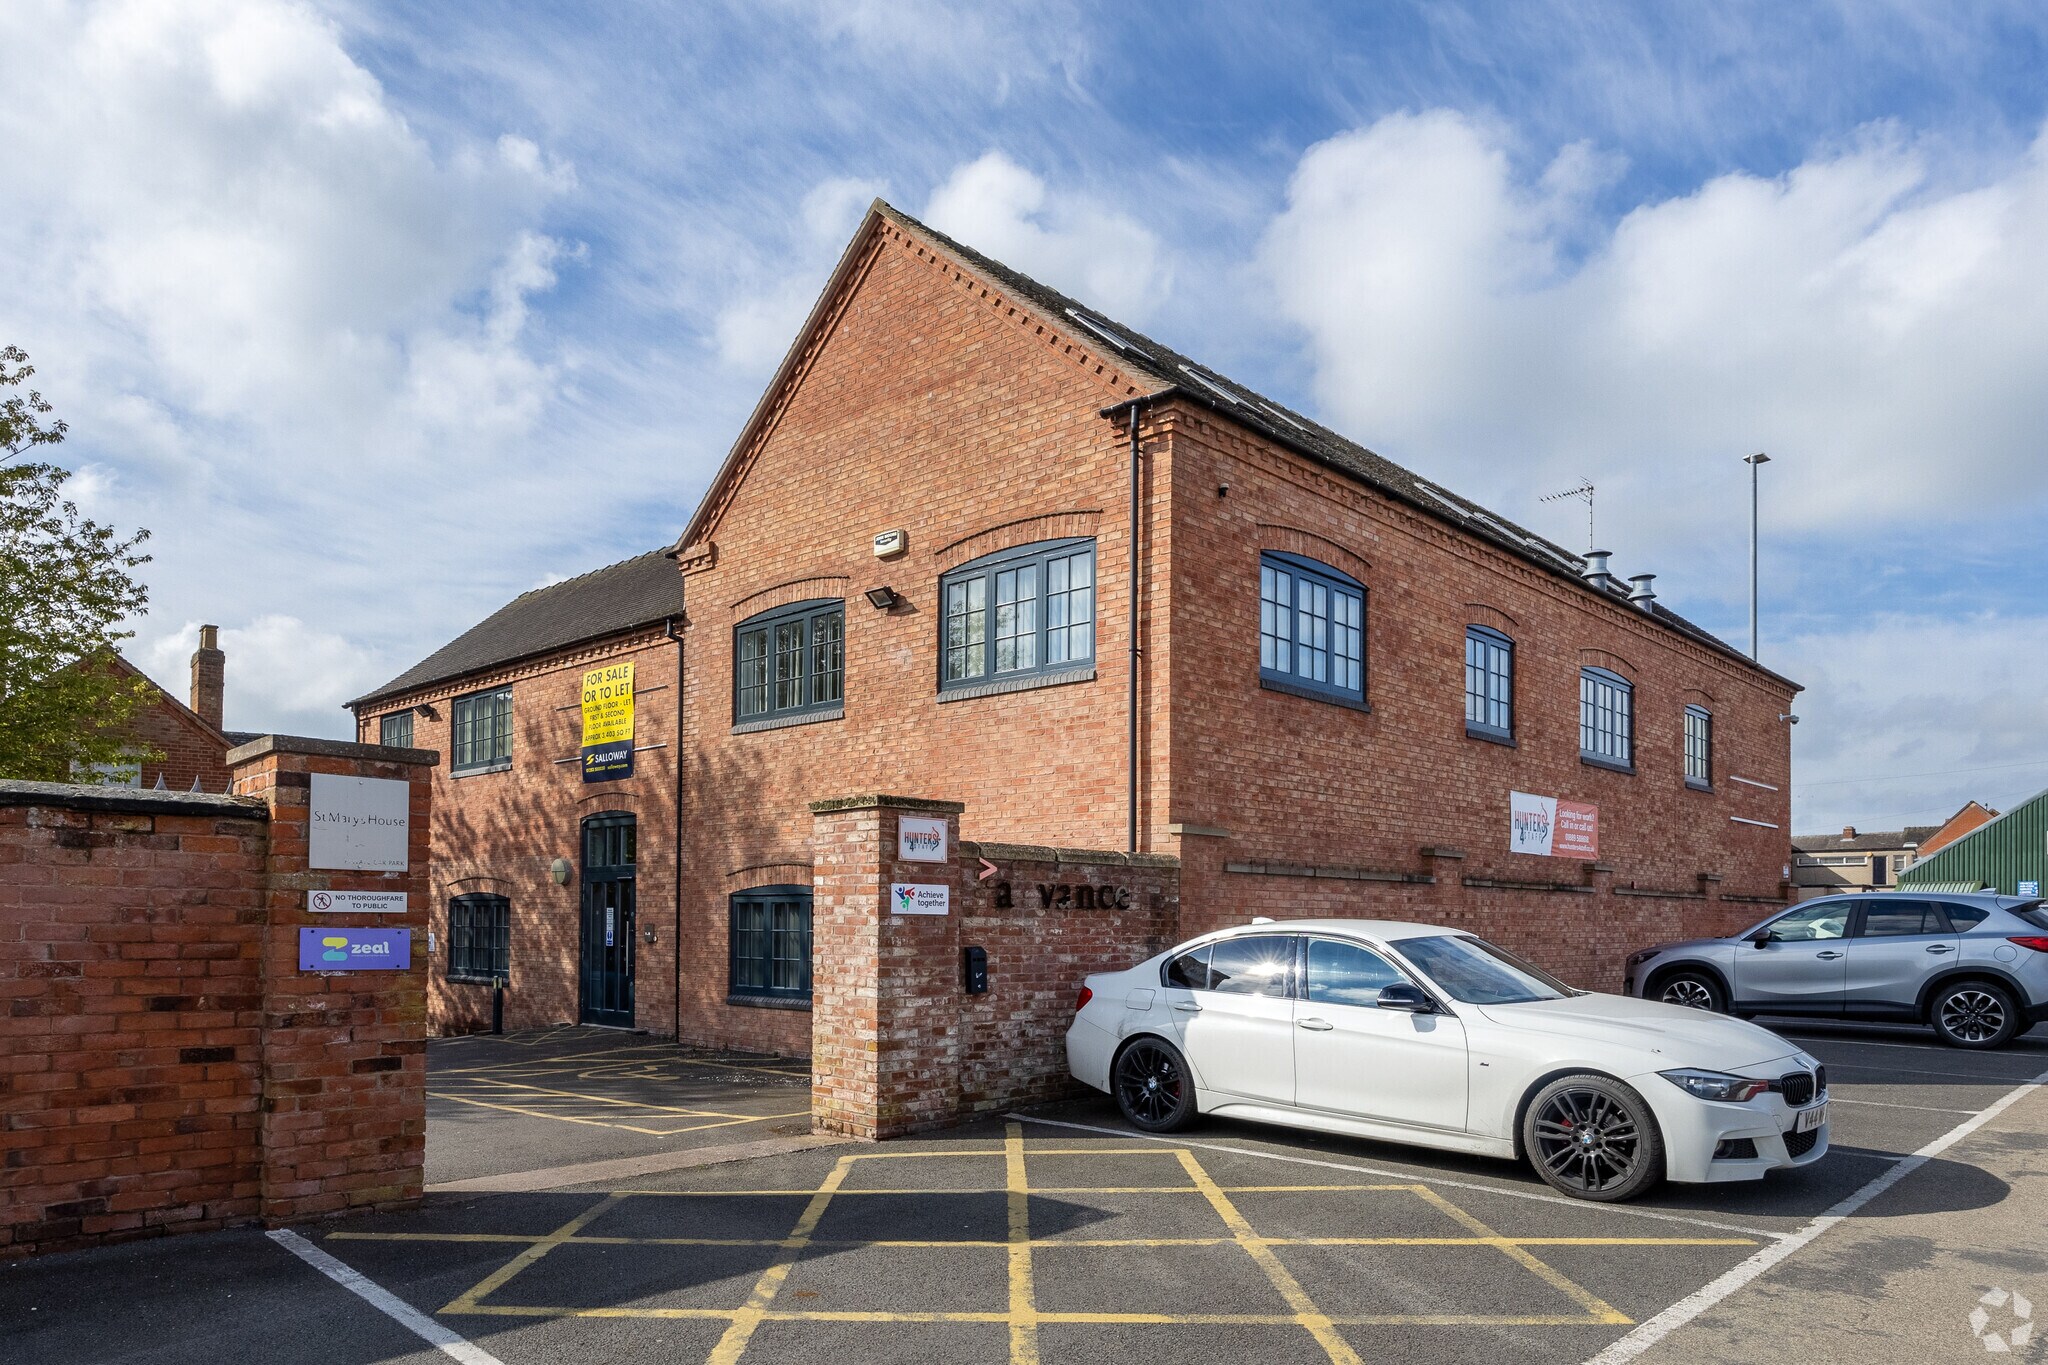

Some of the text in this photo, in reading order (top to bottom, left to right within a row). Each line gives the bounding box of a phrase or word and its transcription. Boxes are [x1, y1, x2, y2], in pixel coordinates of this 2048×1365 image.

[587, 666, 628, 686] FOR SALE
[584, 683, 630, 703] OR TO LET
[584, 704, 602, 713] GROUND
[603, 701, 618, 710] FLOOR
[605, 709, 625, 718] SECOND
[589, 718, 627, 731] FLOOR AVAILABLE
[585, 733, 601, 742] APPROX
[616, 729, 624, 737] SQ
[595, 750, 628, 763] SALLOWAY
[314, 810, 326, 822] St
[368, 814, 406, 827] House
[1515, 810, 1546, 833] HUNTERS
[1559, 809, 1576, 821] Looking
[1582, 813, 1595, 822] work?
[1560, 819, 1569, 829] Call
[1579, 822, 1587, 831] call
[904, 831, 938, 846] HUNTERS
[347, 894, 404, 902] THOROUGHFARE
[918, 890, 944, 899] Achieve
[918, 899, 946, 909] together
[351, 941, 390, 954] zeal
